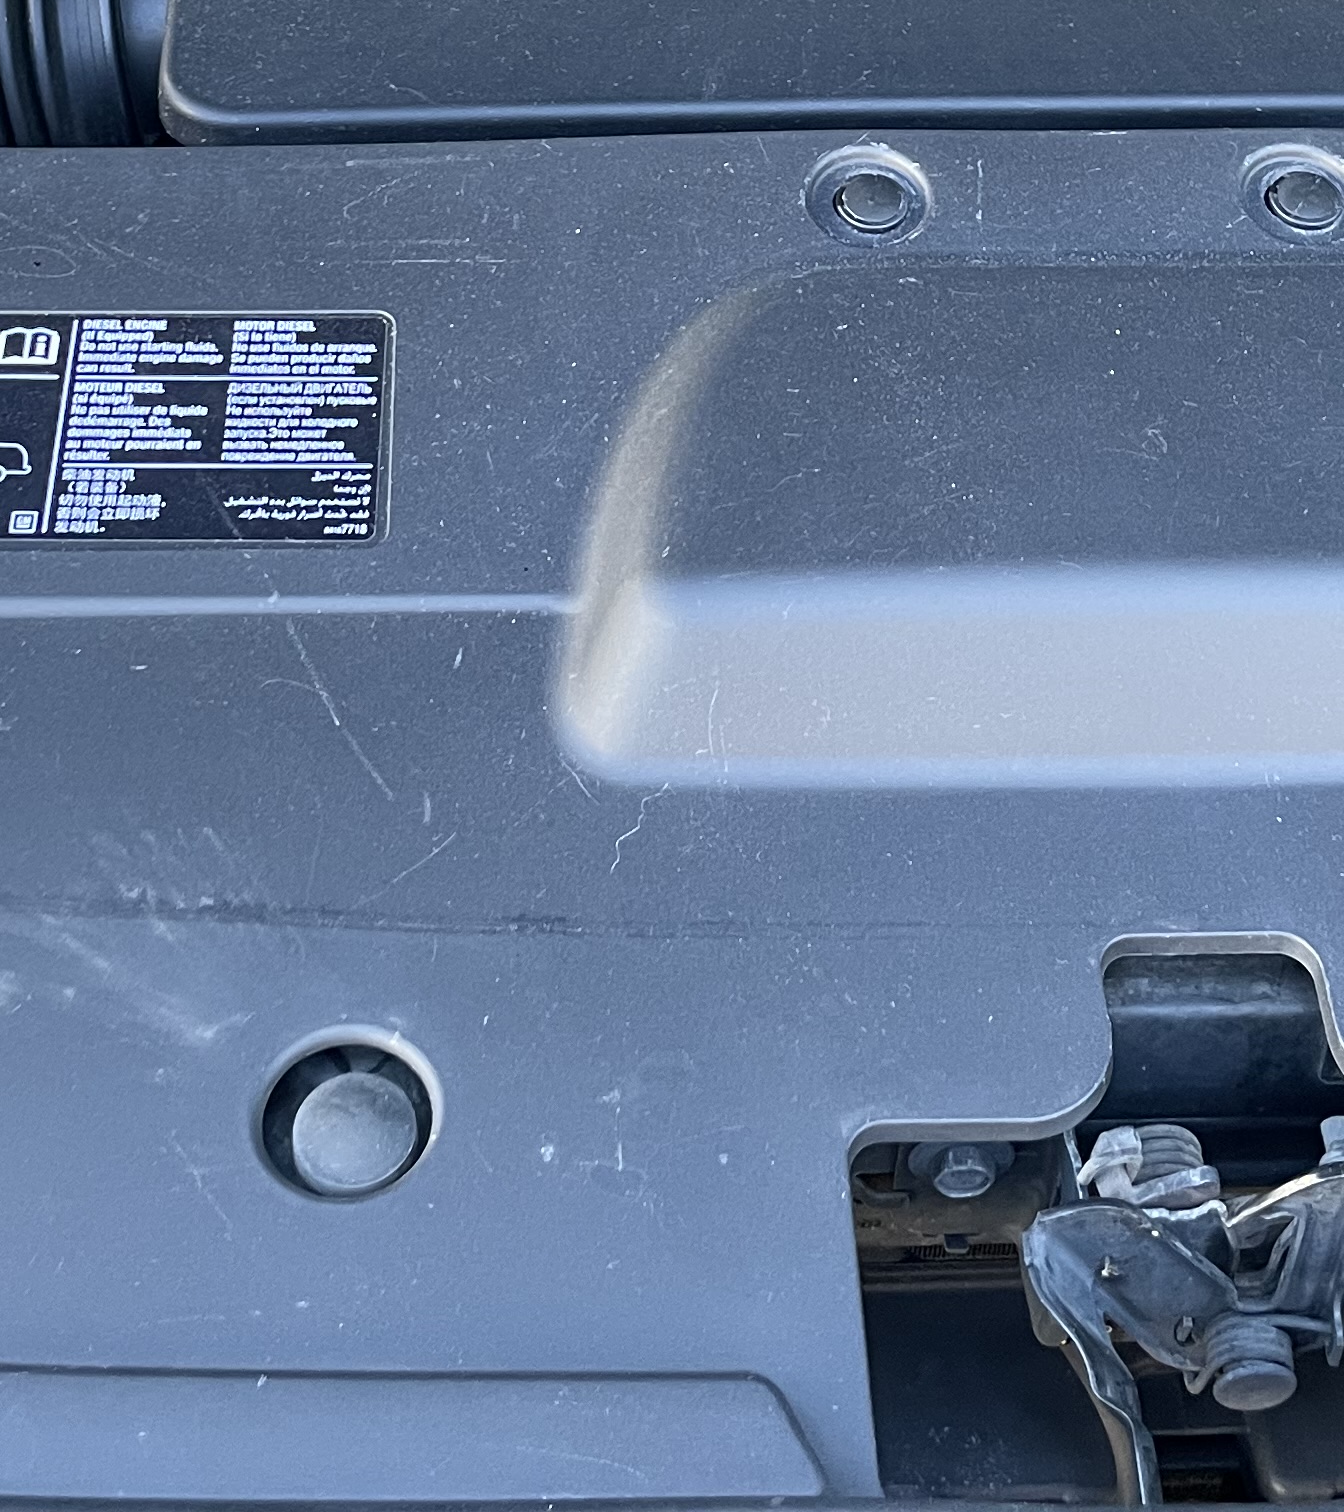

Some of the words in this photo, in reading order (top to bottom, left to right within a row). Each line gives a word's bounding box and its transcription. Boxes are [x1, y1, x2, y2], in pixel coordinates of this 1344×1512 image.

[83, 319, 123, 329] DIESEL
[124, 319, 168, 330] ENGINE
[234, 321, 275, 331] MOTOR
[276, 321, 316, 331] DIESEL
[97, 331, 154, 341] Equipped)
[80, 342, 96, 351] Do
[97, 342, 117, 351] not
[118, 343, 139, 351] use
[140, 342, 183, 353] starting
[232, 343, 248, 352] No
[249, 344, 270, 352] use
[272, 343, 308, 353] fluidos
[310, 343, 325, 353] de
[327, 344, 378, 353] arranque.
[78, 352, 137, 362] Immediate
[138, 353, 177, 364] engine
[178, 354, 224, 365] damage
[231, 353, 246, 363] Se
[247, 354, 289, 364] pueden
[290, 354, 337, 365] producir
[76, 364, 98, 373] can
[99, 364, 135, 373] result.
[292, 365, 307, 374] en
[308, 365, 319, 374] el
[321, 365, 356, 374] motor.
[74, 382, 123, 393] MOTEUR
[124, 382, 165, 393] DIESEL
[227, 382, 303, 394] ДИЗЕЛЬНЫЙ
[304, 382, 372, 394] ДВИГАТЕЛЬ
[89, 393, 134, 405] équipé)
[71, 405, 88, 415] Ne
[88, 406, 111, 416] pas
[112, 405, 151, 415] utiliser
[152, 405, 168, 415] de
[169, 405, 208, 417] liquide
[148, 416, 172, 426] Des
[67, 427, 131, 439] dommages
[132, 427, 192, 438] immédiats
[65, 439, 81, 449] au
[83, 440, 125, 449] moteur
[125, 439, 184, 451] pourraient
[185, 440, 202, 450] en
[323, 524, 368, 534] 7718
